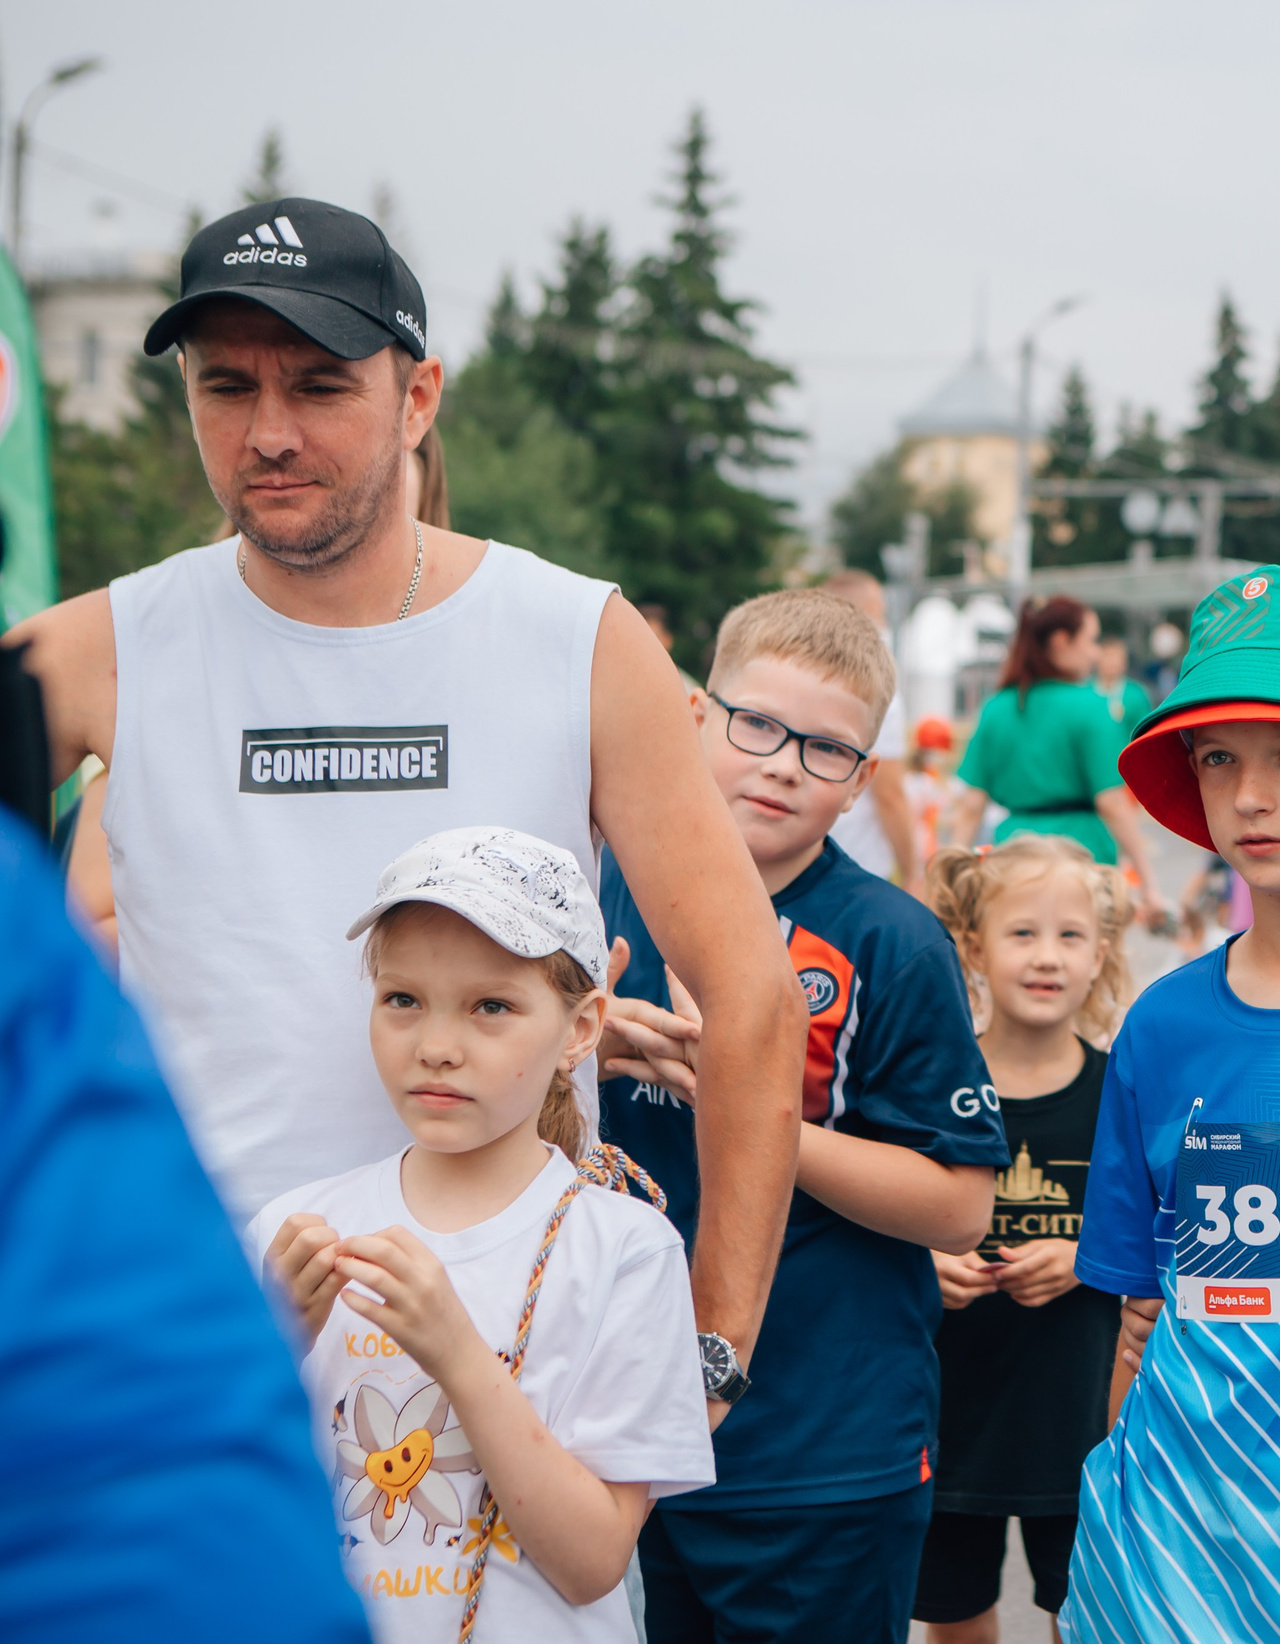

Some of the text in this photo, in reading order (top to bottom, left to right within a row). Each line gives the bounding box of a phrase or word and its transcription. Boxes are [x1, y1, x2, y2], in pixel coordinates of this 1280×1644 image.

[223, 246, 308, 267] adidas
[251, 746, 437, 783] CONFIDENCE
[988, 1213, 1084, 1235] Т-СИТ
[1208, 1293, 1265, 1308] Альфа Банк
[344, 1331, 407, 1358] КОБ
